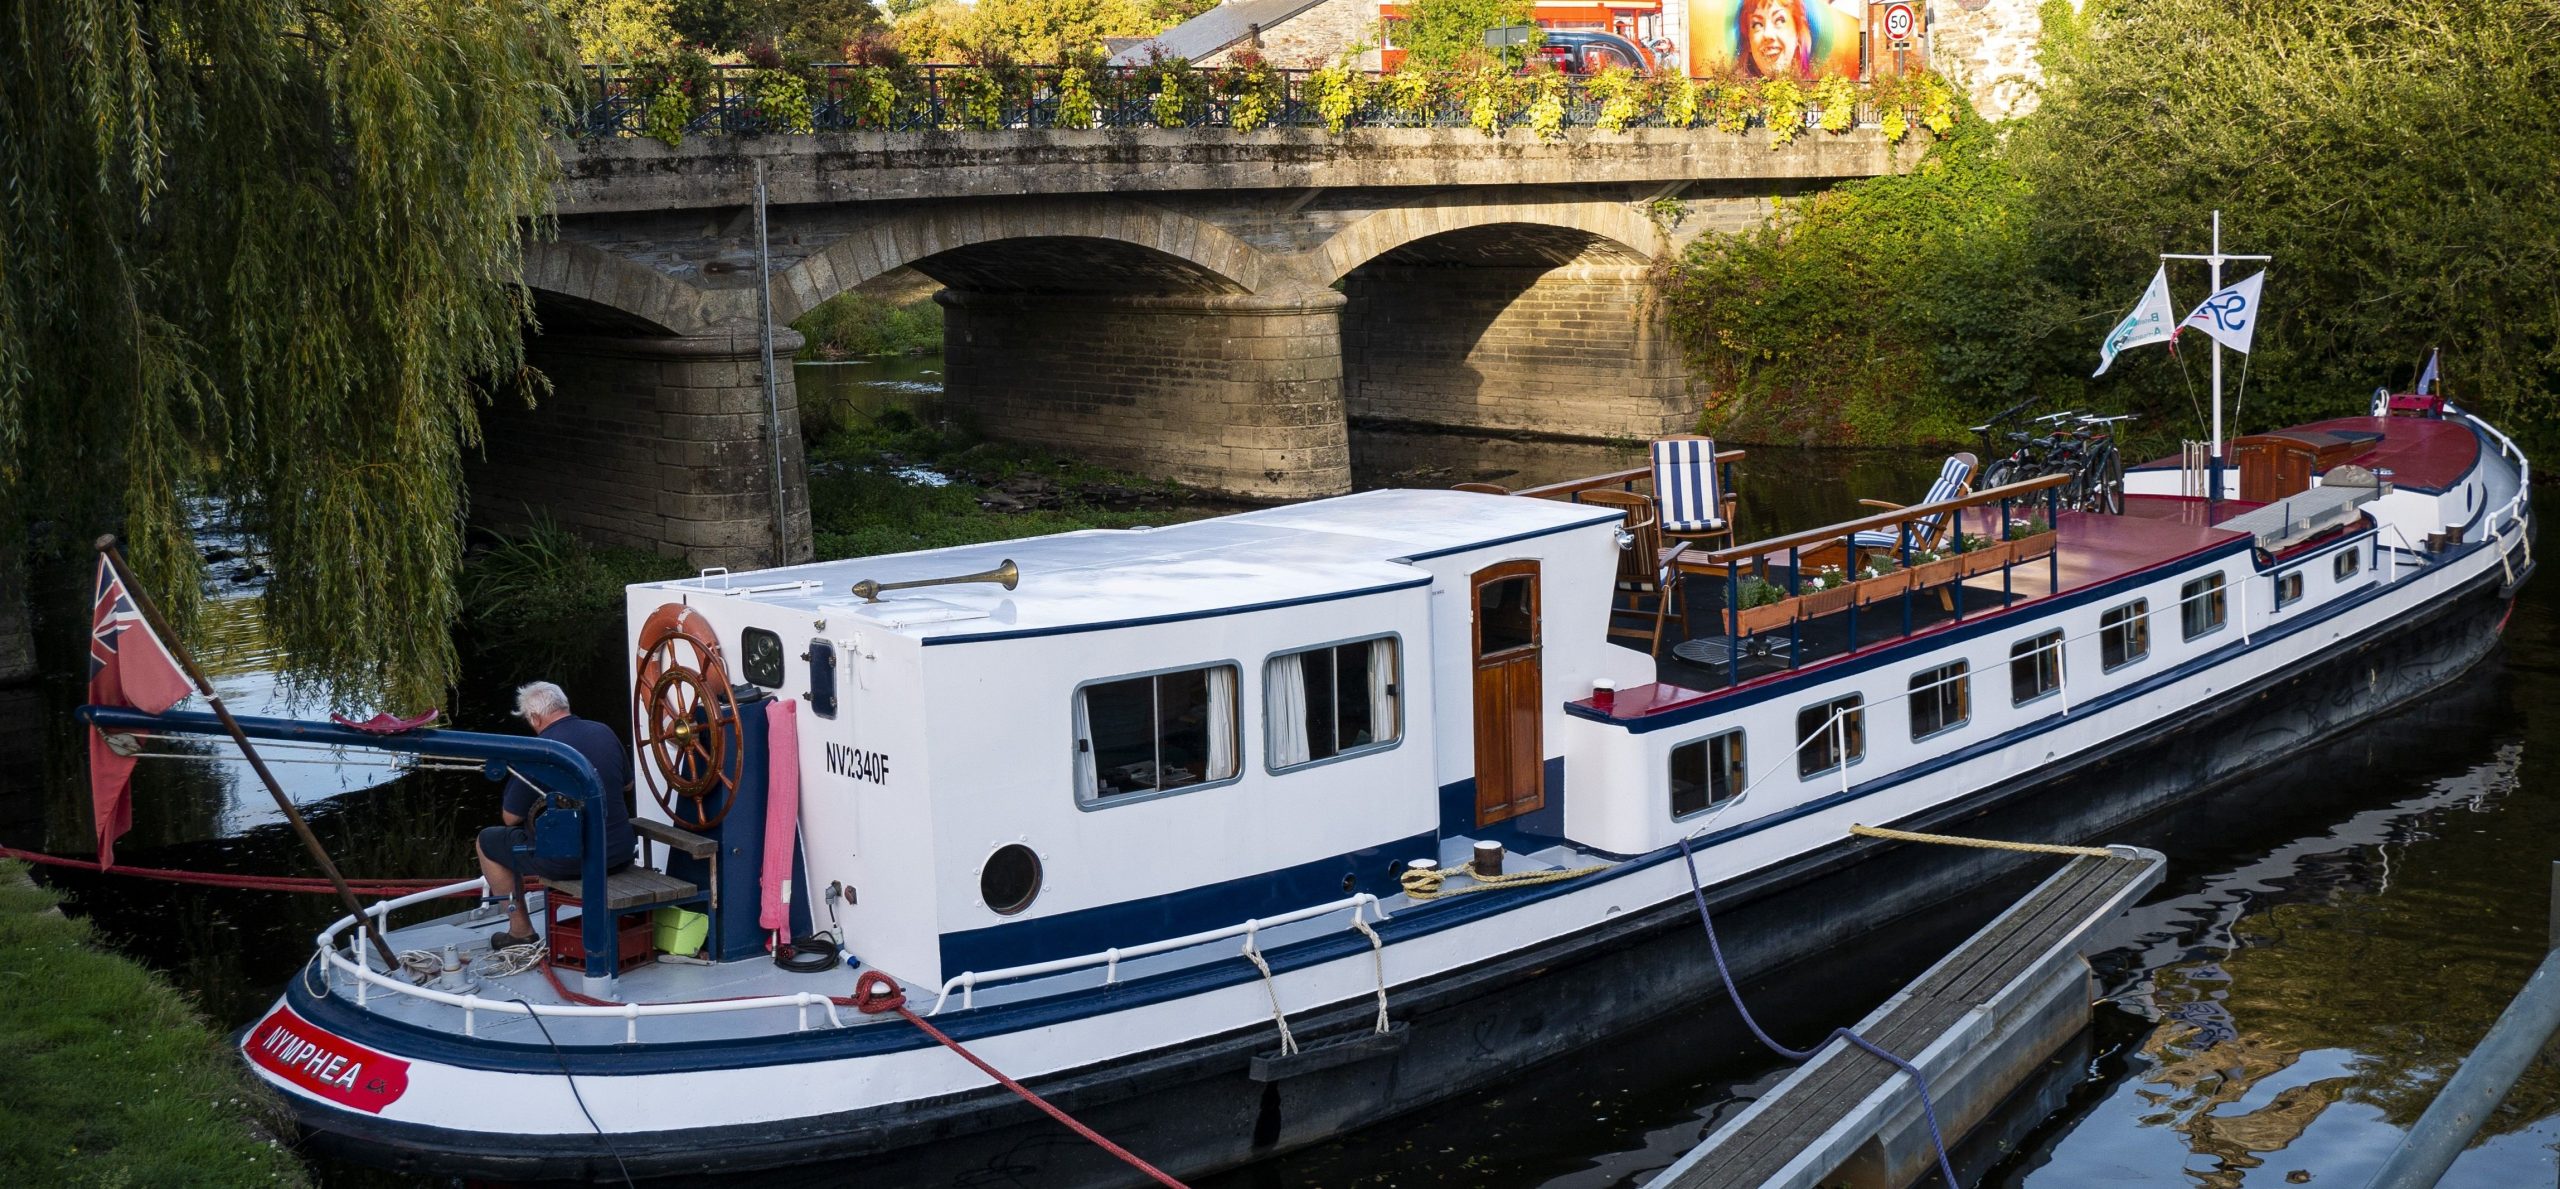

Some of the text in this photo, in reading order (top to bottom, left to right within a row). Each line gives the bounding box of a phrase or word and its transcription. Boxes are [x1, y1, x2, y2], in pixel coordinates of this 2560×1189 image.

[1891, 15, 1907, 28] 50
[826, 741, 889, 785] NV2340F
[262, 1025, 363, 1091] NYMPHEA
